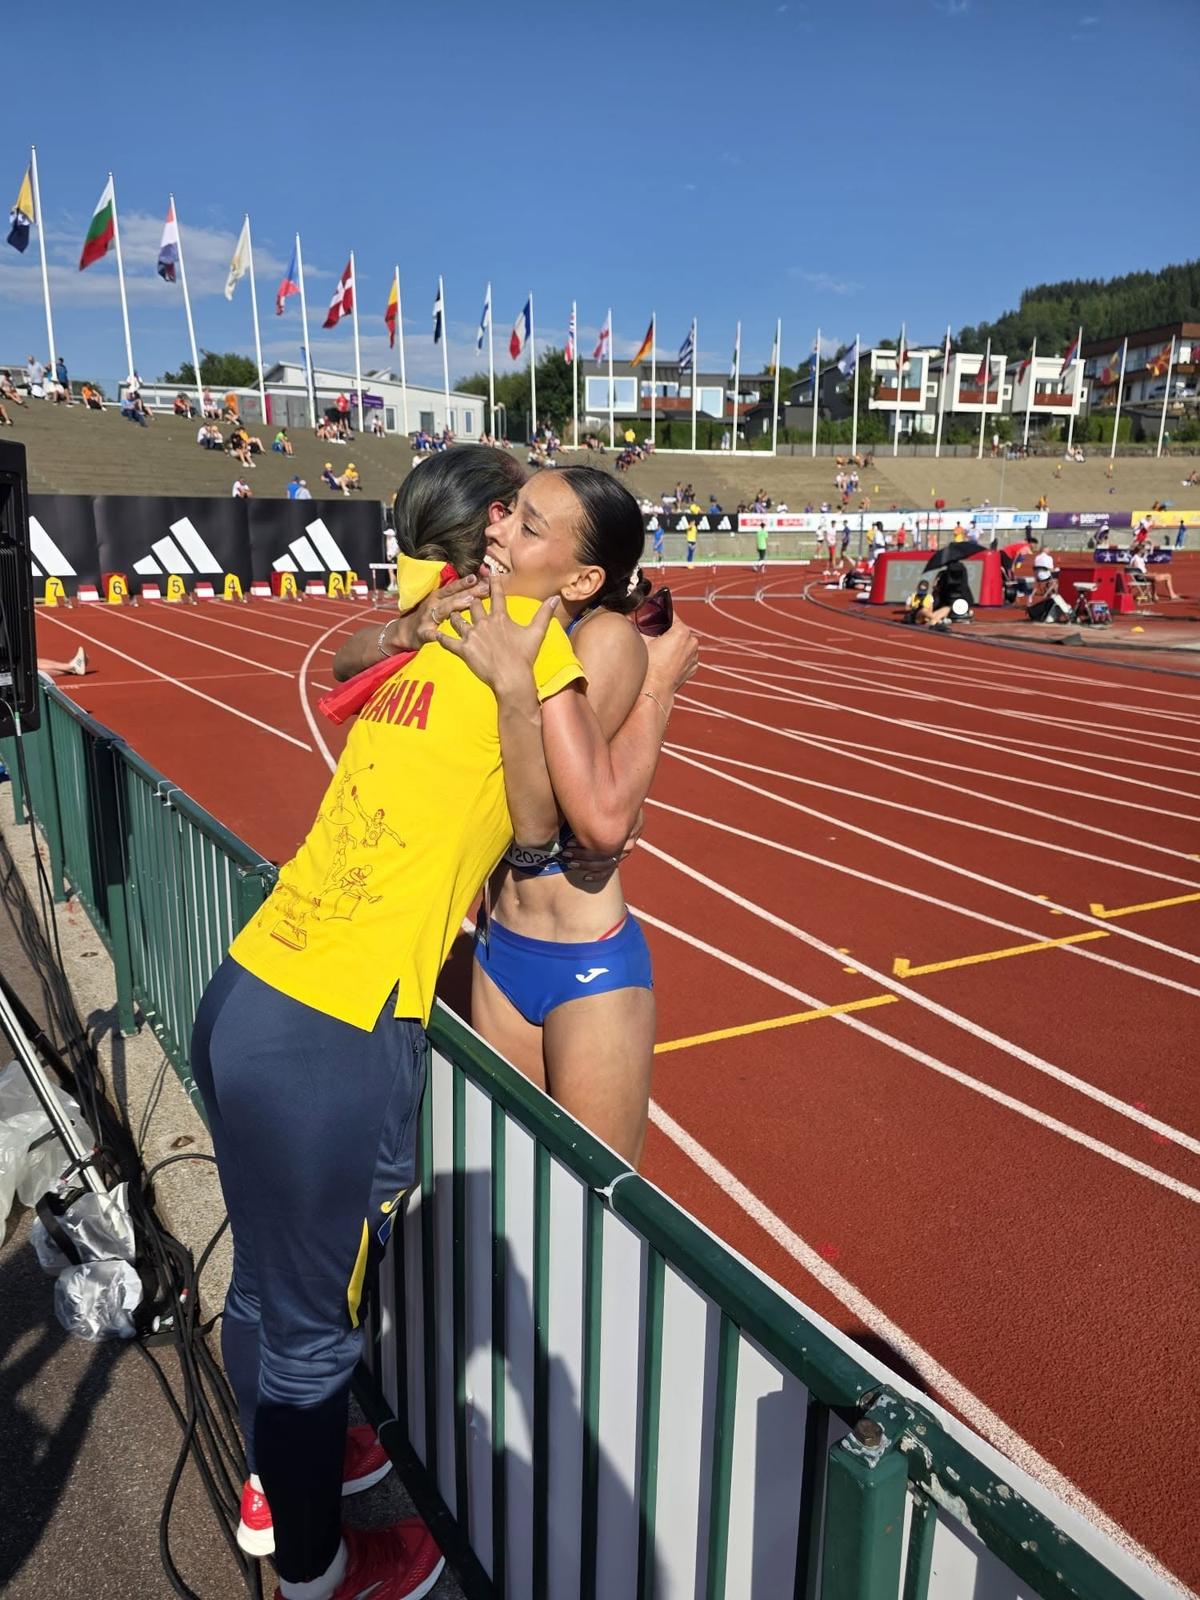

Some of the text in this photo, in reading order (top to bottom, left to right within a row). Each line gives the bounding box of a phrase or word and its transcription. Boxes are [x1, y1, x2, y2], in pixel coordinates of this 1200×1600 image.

[50, 582, 59, 597] 7
[113, 581, 122, 595] 6
[172, 580, 181, 594] 5
[228, 579, 236, 592] 4
[285, 577, 292, 591] 3
[333, 577, 341, 590] 2
